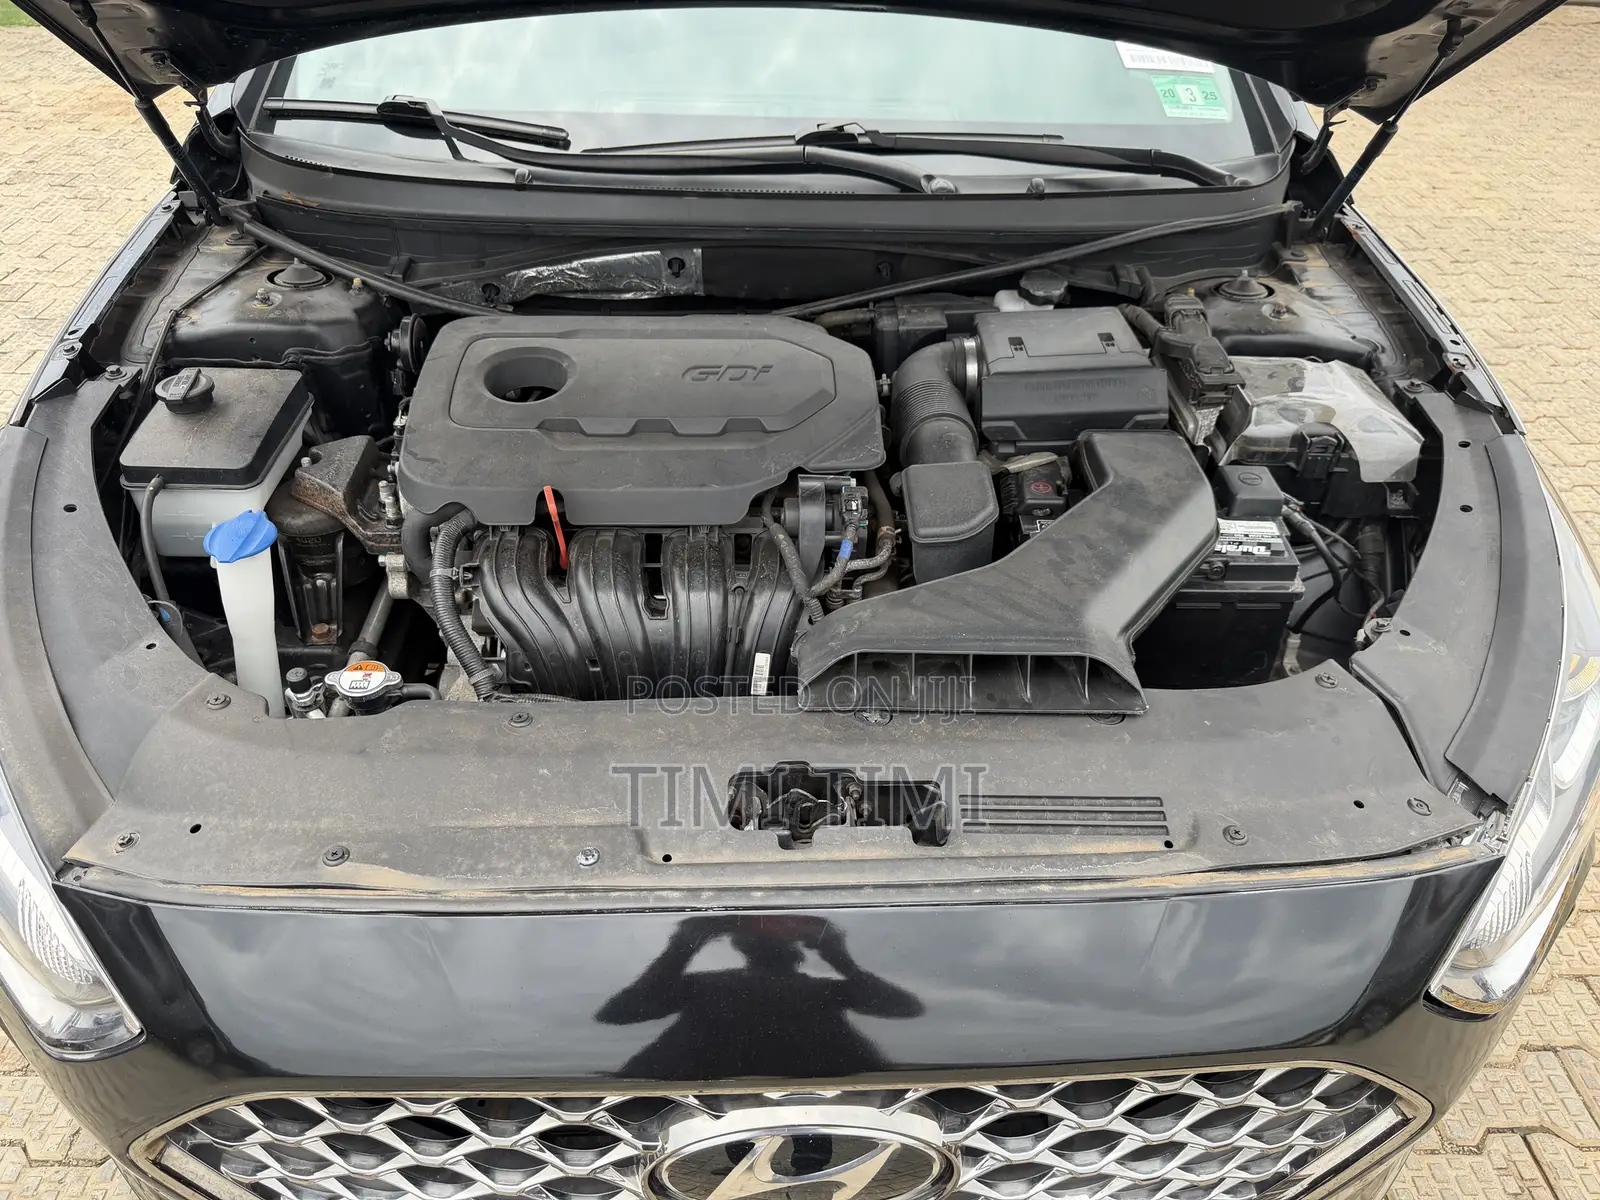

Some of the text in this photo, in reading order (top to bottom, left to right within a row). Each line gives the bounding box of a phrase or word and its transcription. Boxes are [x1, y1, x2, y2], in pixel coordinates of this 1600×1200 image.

[1161, 87, 1217, 102] 20 3 25
